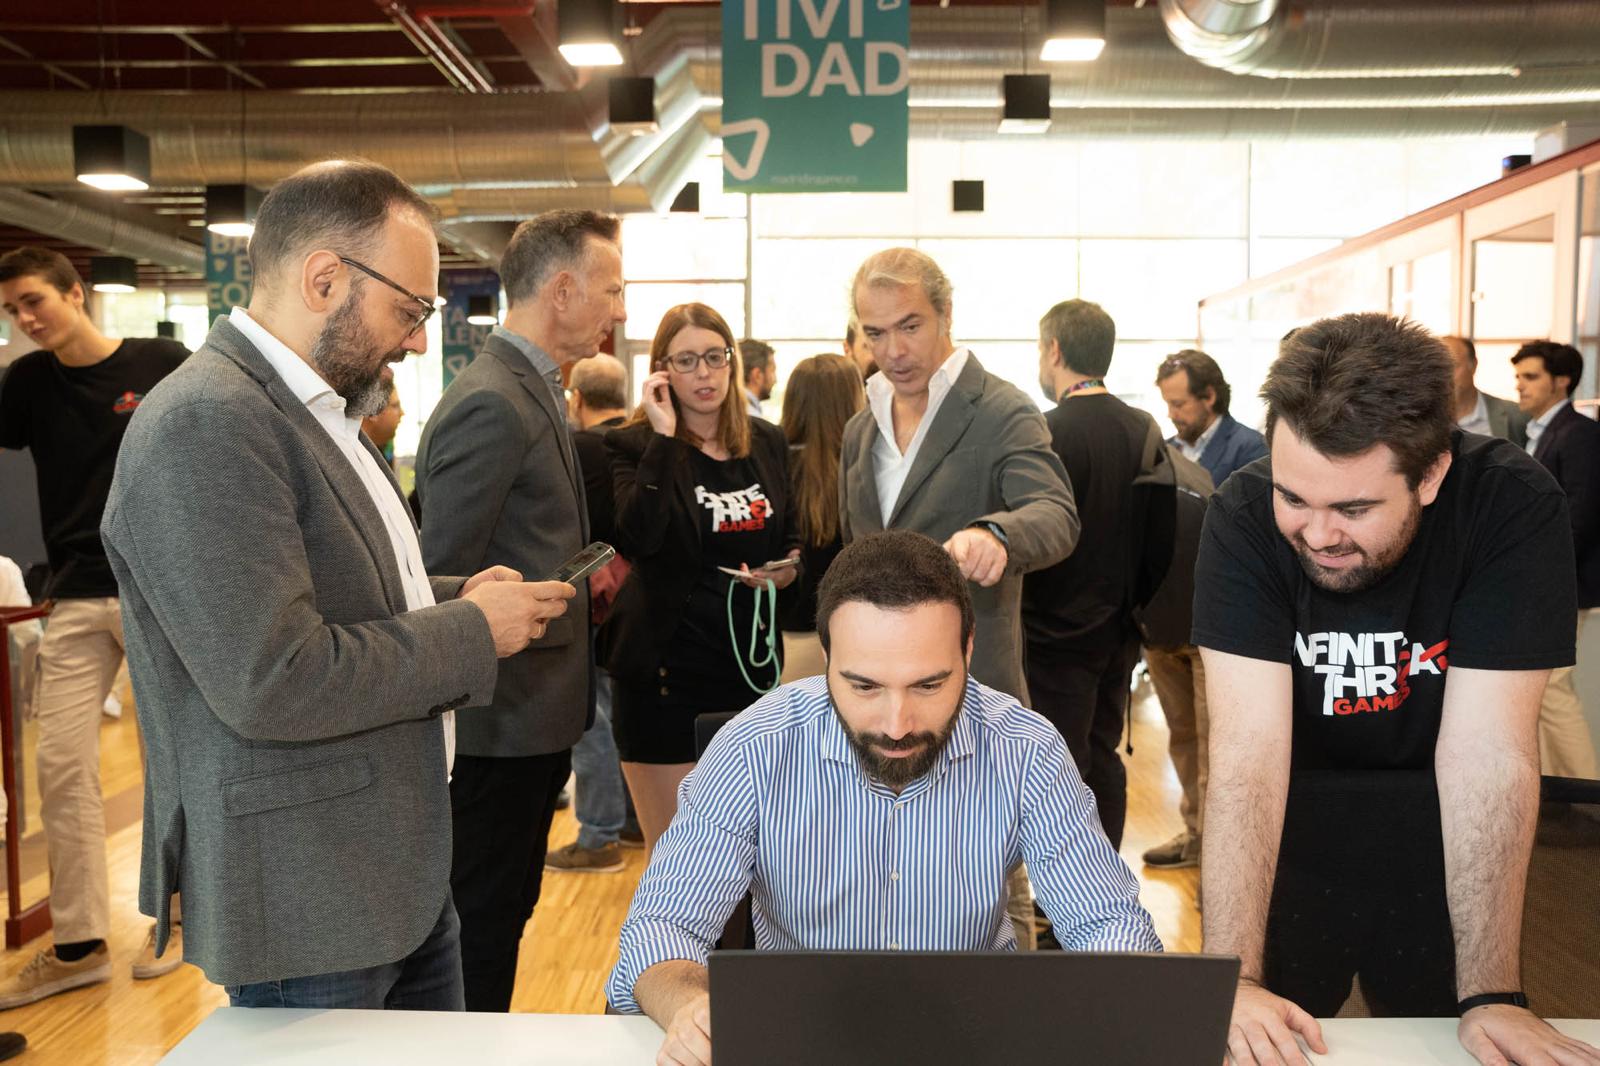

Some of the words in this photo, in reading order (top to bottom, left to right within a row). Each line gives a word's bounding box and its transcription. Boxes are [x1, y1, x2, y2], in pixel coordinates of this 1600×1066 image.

[761, 42, 909, 97] DAD
[719, 519, 765, 532] GAMES
[1293, 631, 1409, 667] NFINIT
